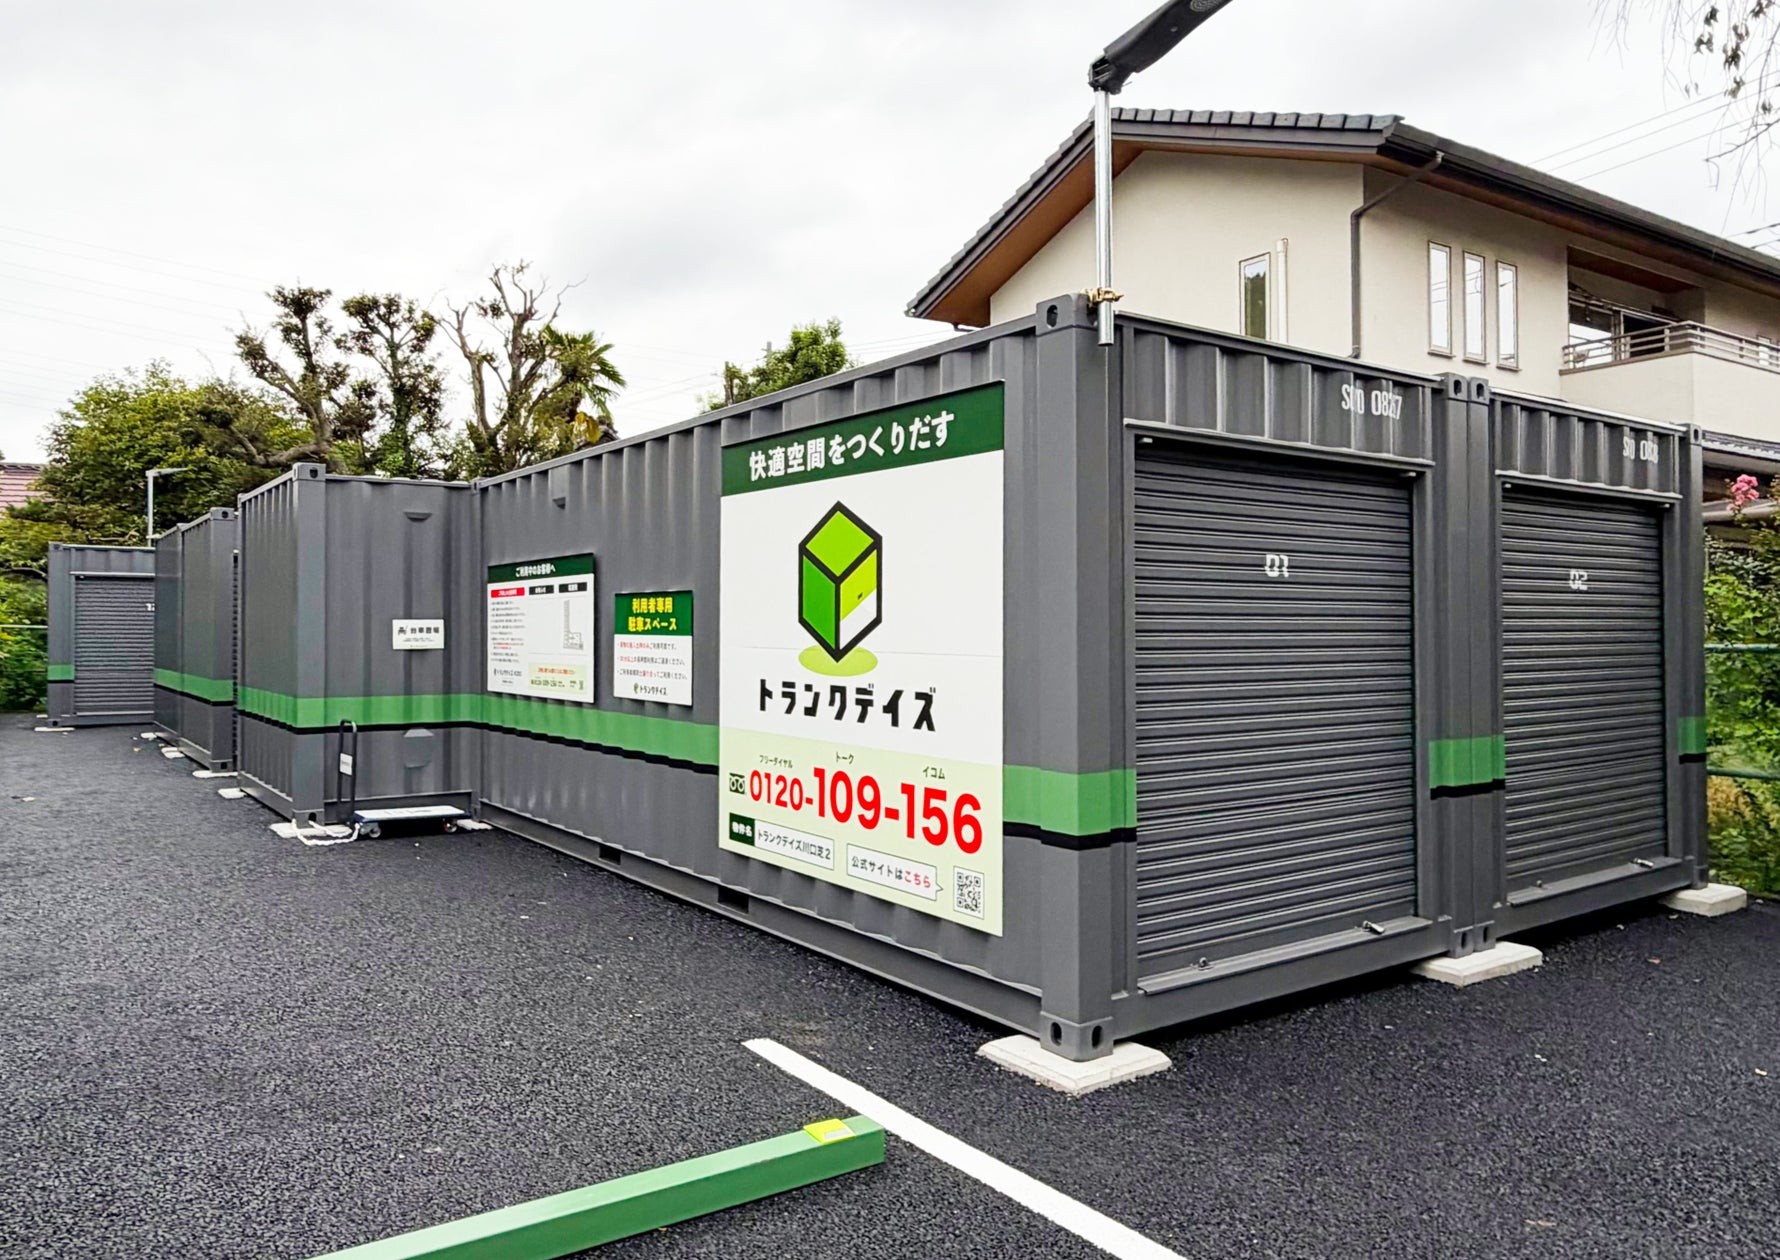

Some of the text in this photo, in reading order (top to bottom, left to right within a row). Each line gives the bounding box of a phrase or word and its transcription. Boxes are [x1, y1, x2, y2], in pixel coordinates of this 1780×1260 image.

[749, 410, 955, 481] 快適空間をつくりだす
[1264, 553, 1289, 578] 01
[1569, 570, 1588, 591] 02
[632, 597, 673, 614] 利用者専用
[628, 616, 677, 632] 駐車スペース
[760, 678, 937, 732] トランクデイズ
[836, 752, 854, 765] トーク
[922, 765, 945, 780] イコム
[750, 767, 983, 854] 0120-109-156
[852, 855, 932, 889] 公式サイトはこちら
